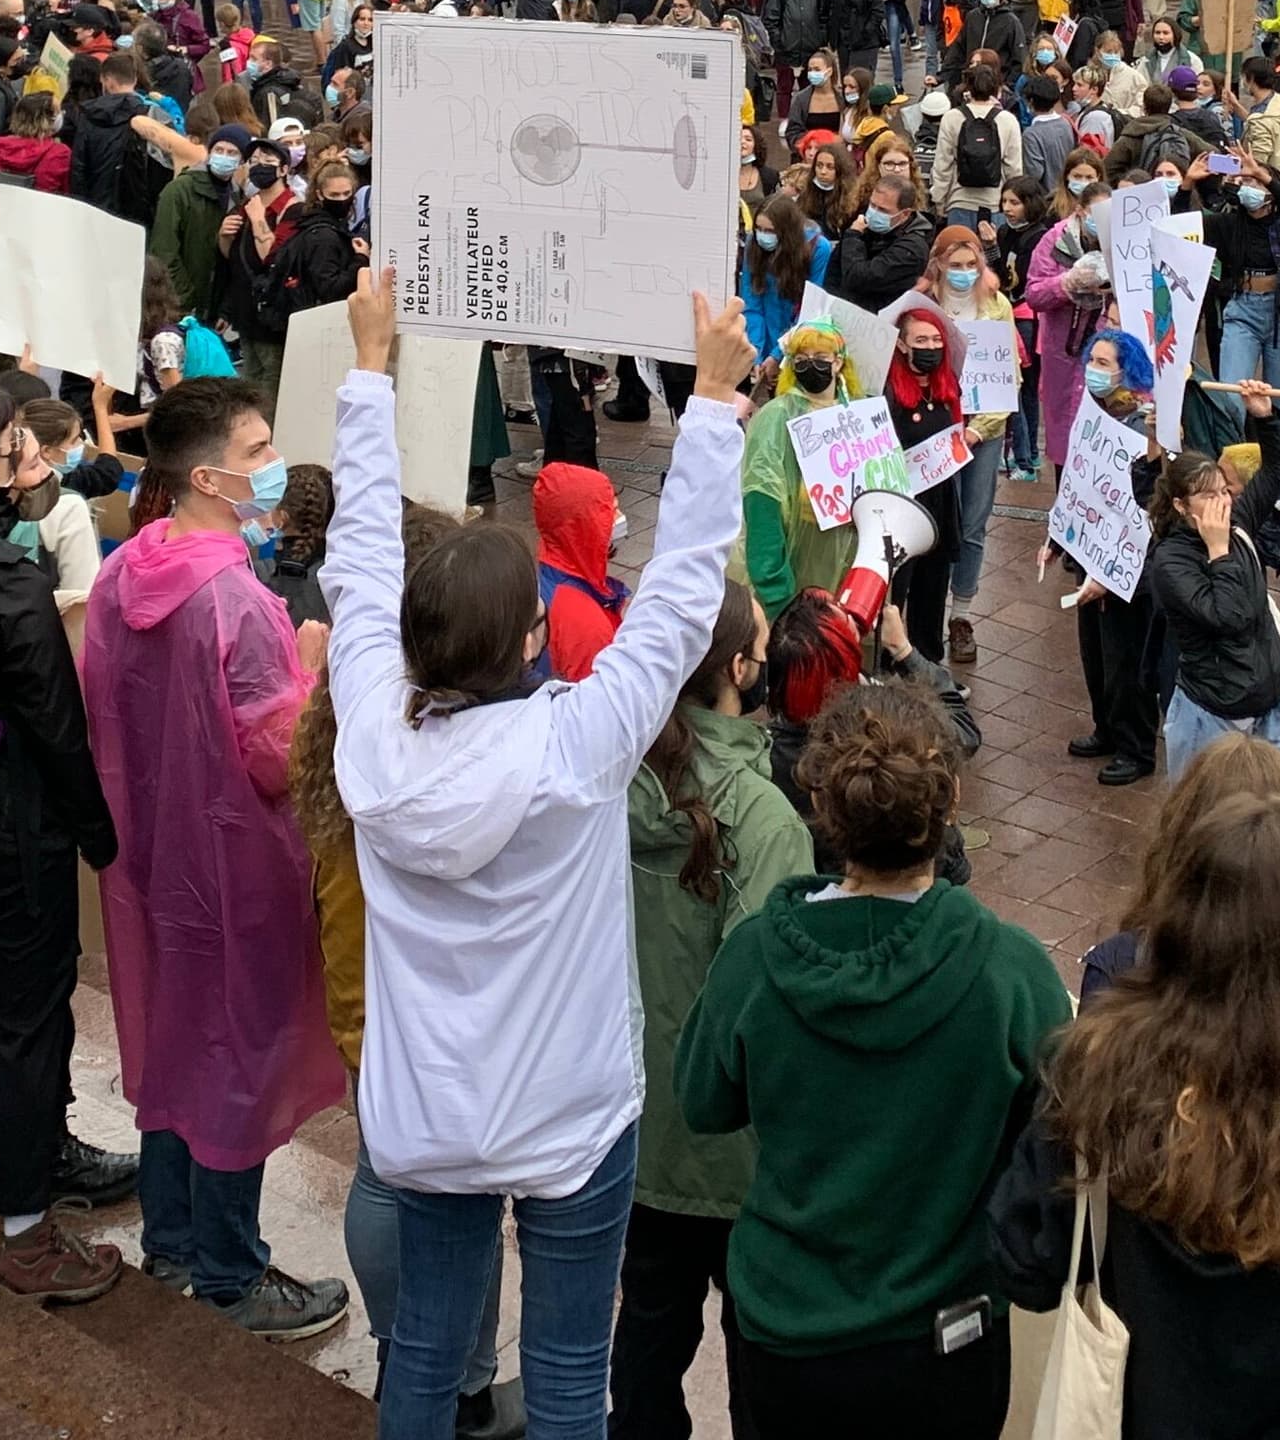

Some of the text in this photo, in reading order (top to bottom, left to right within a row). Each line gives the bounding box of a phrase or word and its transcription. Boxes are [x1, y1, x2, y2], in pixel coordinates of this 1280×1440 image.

[388, 248, 398, 265] 517
[417, 194, 430, 315] PEDESTAL FAN
[466, 207, 479, 319] VENTILATEUR
[403, 279, 415, 314] 16 IN
[481, 244, 493, 320] SUR PIED
[496, 235, 509, 322] DE 40,6 CM
[994, 344, 1011, 362] de
[792, 409, 865, 458] Bouffe
[1071, 446, 1090, 480] os
[810, 483, 852, 523] Pas
[1077, 521, 1135, 592] humides
[1116, 524, 1145, 570] les
